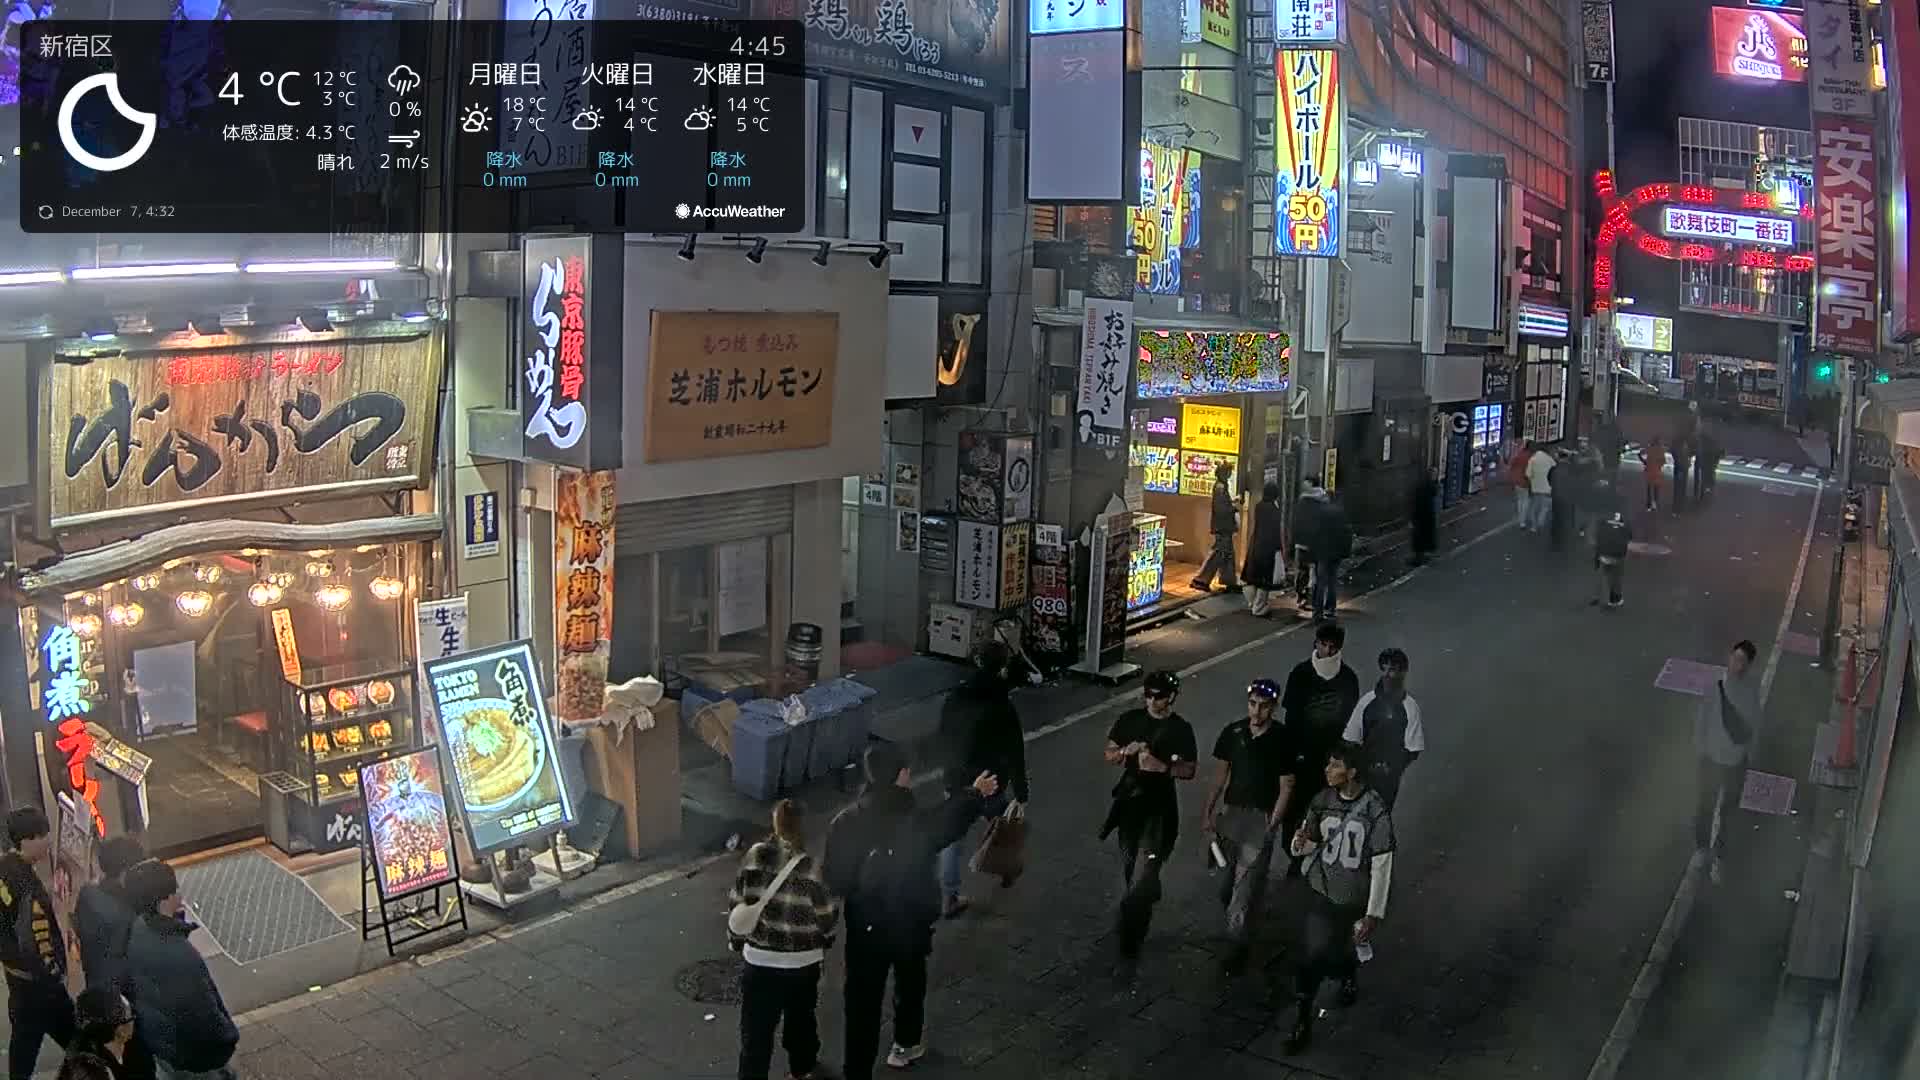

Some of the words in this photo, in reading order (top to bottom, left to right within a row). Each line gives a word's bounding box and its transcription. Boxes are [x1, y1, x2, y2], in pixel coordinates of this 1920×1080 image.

[1292, 51, 1322, 191] ハイボール
[1669, 211, 1789, 242] 歌舞伎町一番街
[1820, 126, 1875, 329] 安楽亭
[560, 255, 586, 401] 東京豚骨
[1098, 308, 1128, 416] お好み焼き
[63, 377, 407, 493] ばんから
[667, 366, 824, 406] 芝浦ホルモン
[1033, 598, 1066, 613] 980
[42, 623, 91, 722] 角煮
[433, 669, 479, 690] TOKYO
[498, 660, 536, 727] 角煮
